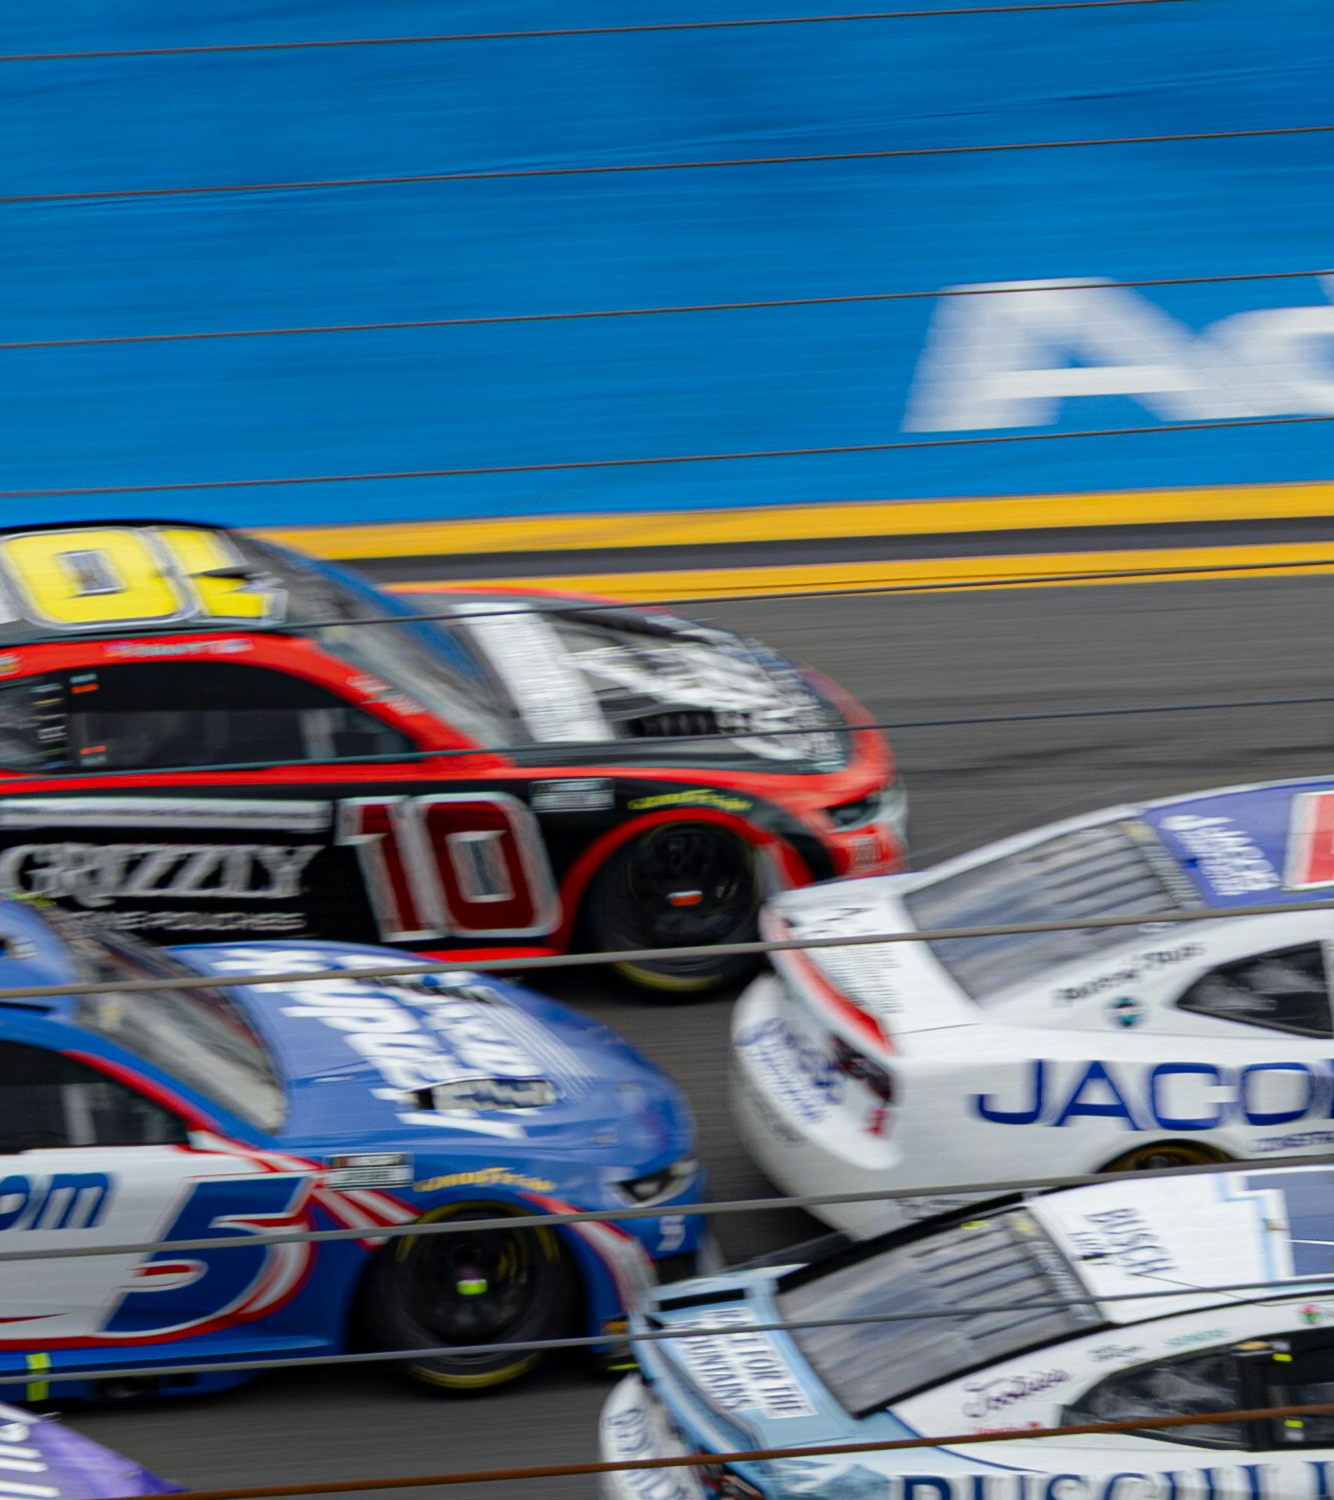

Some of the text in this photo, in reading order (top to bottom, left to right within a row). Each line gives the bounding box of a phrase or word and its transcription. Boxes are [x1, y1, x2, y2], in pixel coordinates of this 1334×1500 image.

[335, 792, 562, 942] 10
[97, 1172, 323, 1336] 5
[1083, 1206, 1180, 1277] BUSCH
[703, 1307, 763, 1347] RAE
[759, 1385, 805, 1411] THE
